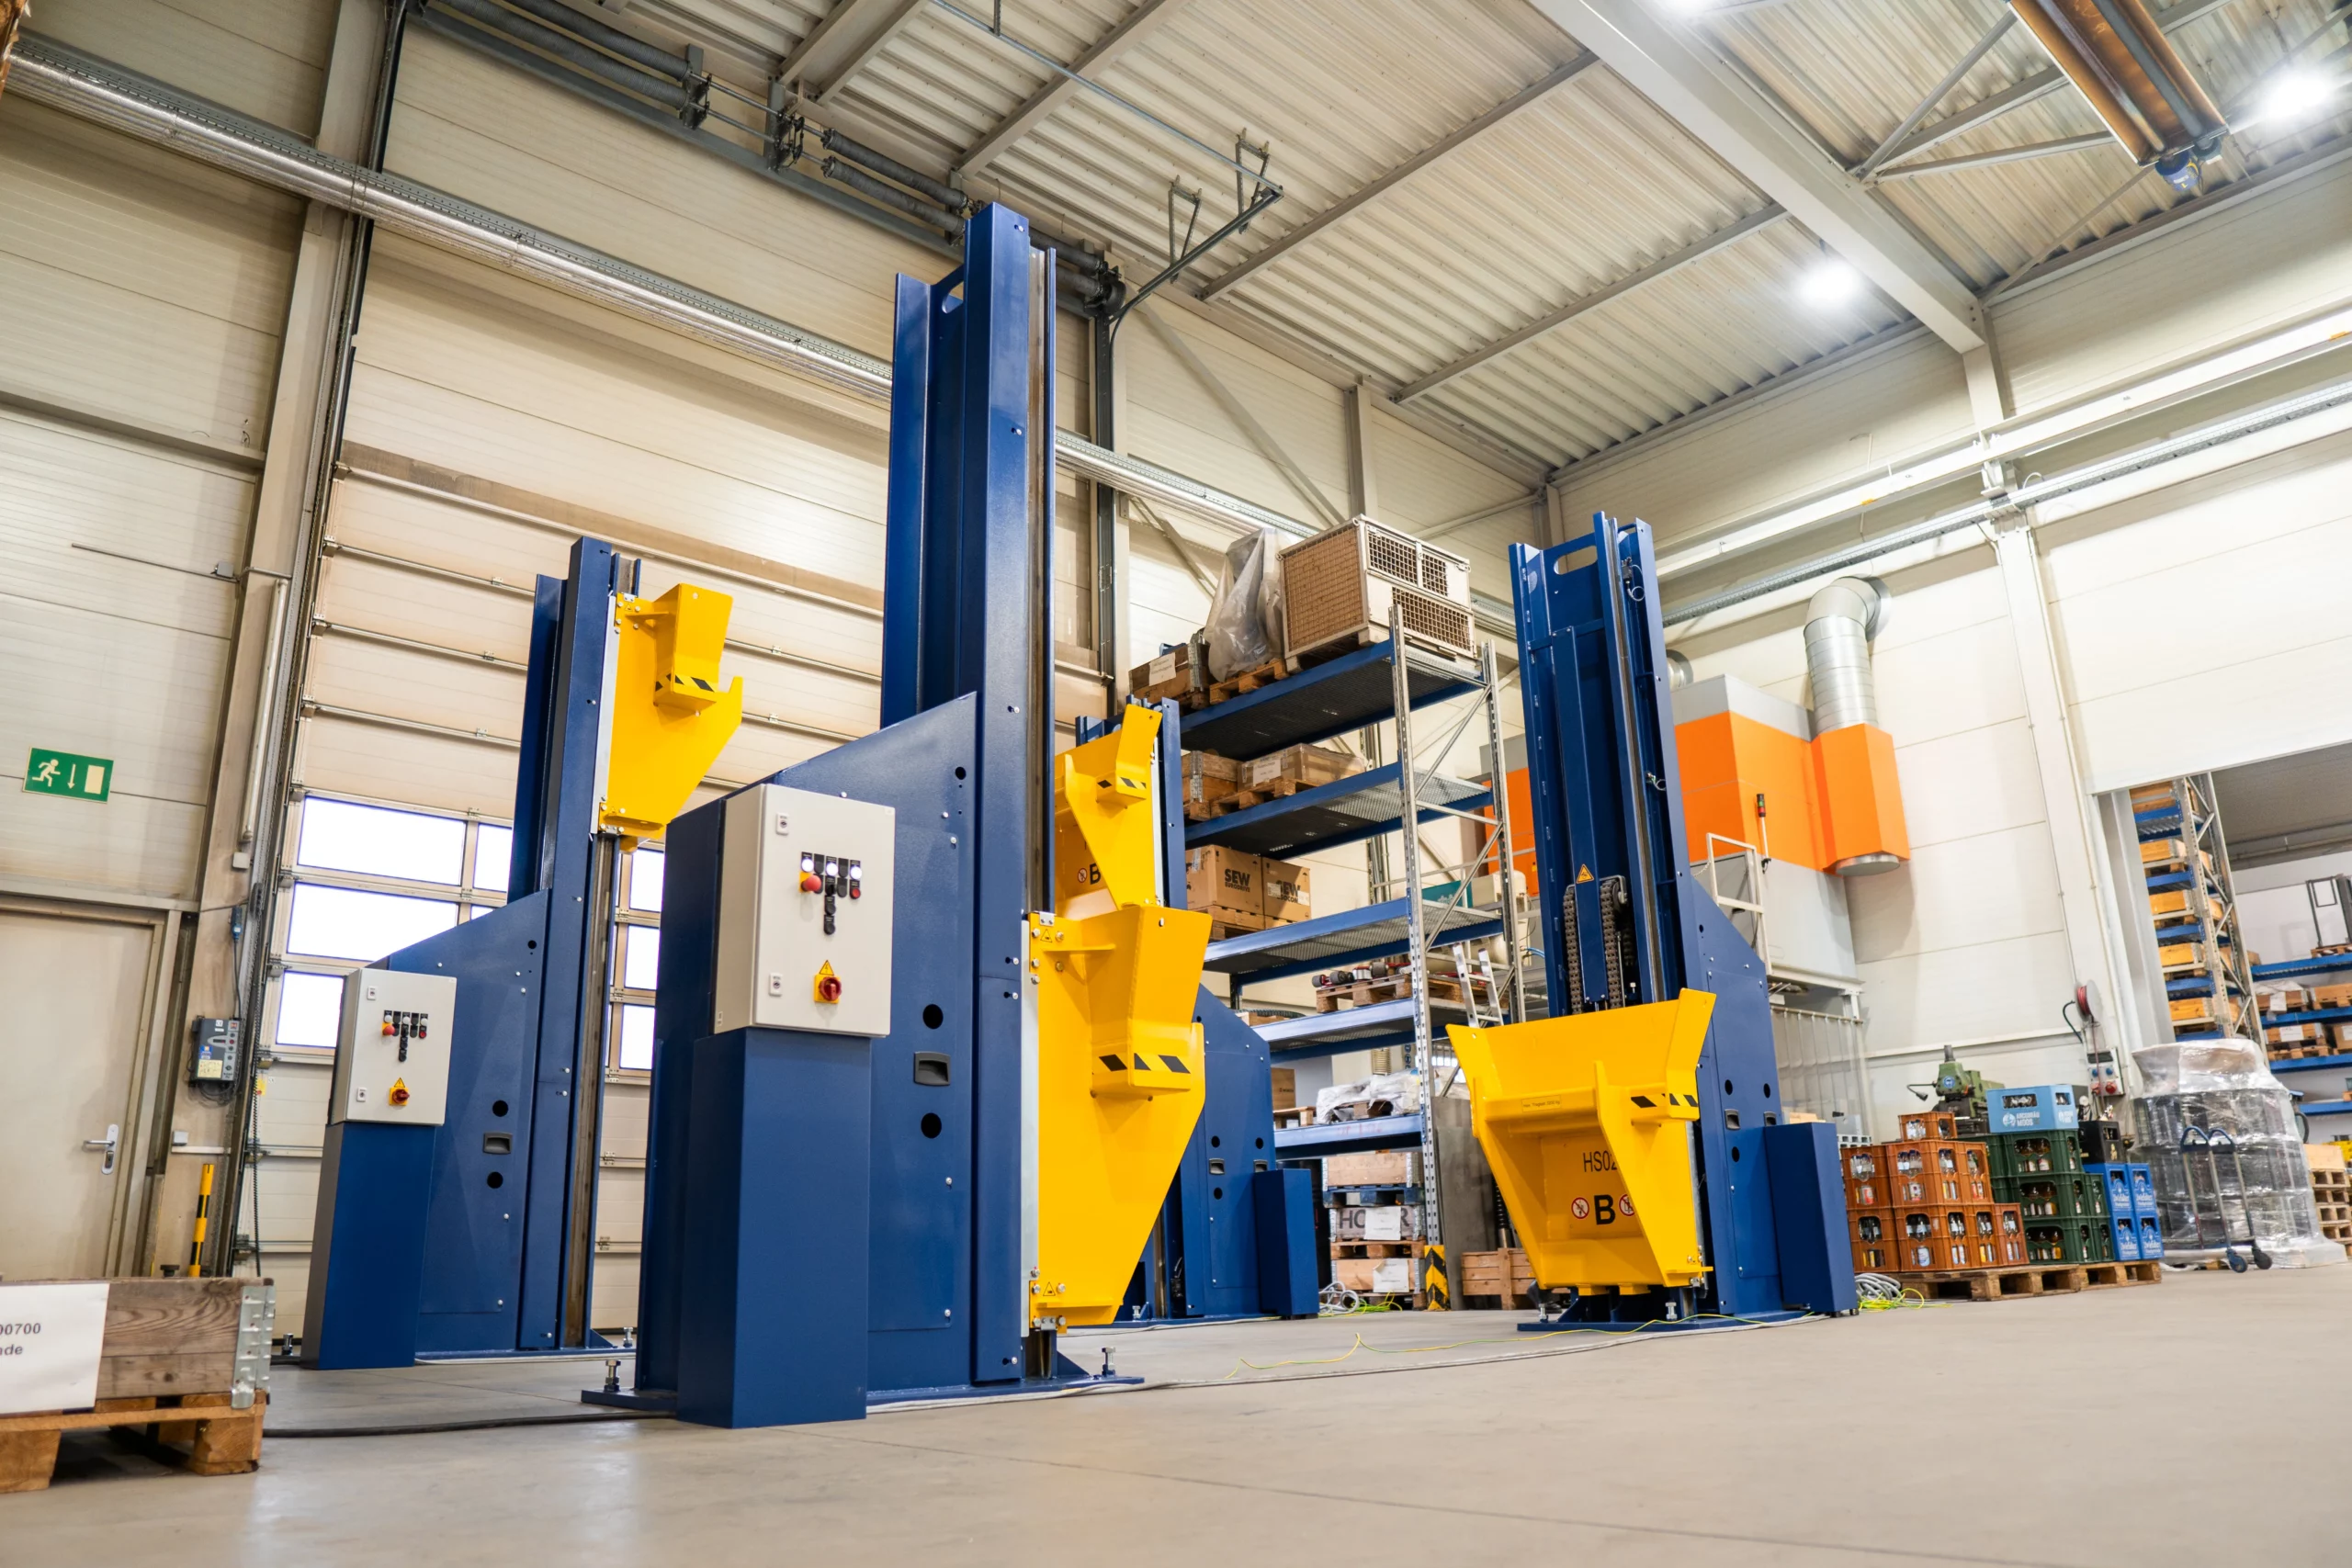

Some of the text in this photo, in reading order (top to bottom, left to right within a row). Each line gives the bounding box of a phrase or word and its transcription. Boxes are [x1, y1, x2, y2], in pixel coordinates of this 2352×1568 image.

[1089, 863, 1102, 886] B
[1225, 868, 1250, 886] SEW
[1594, 1194, 1616, 1225] B
